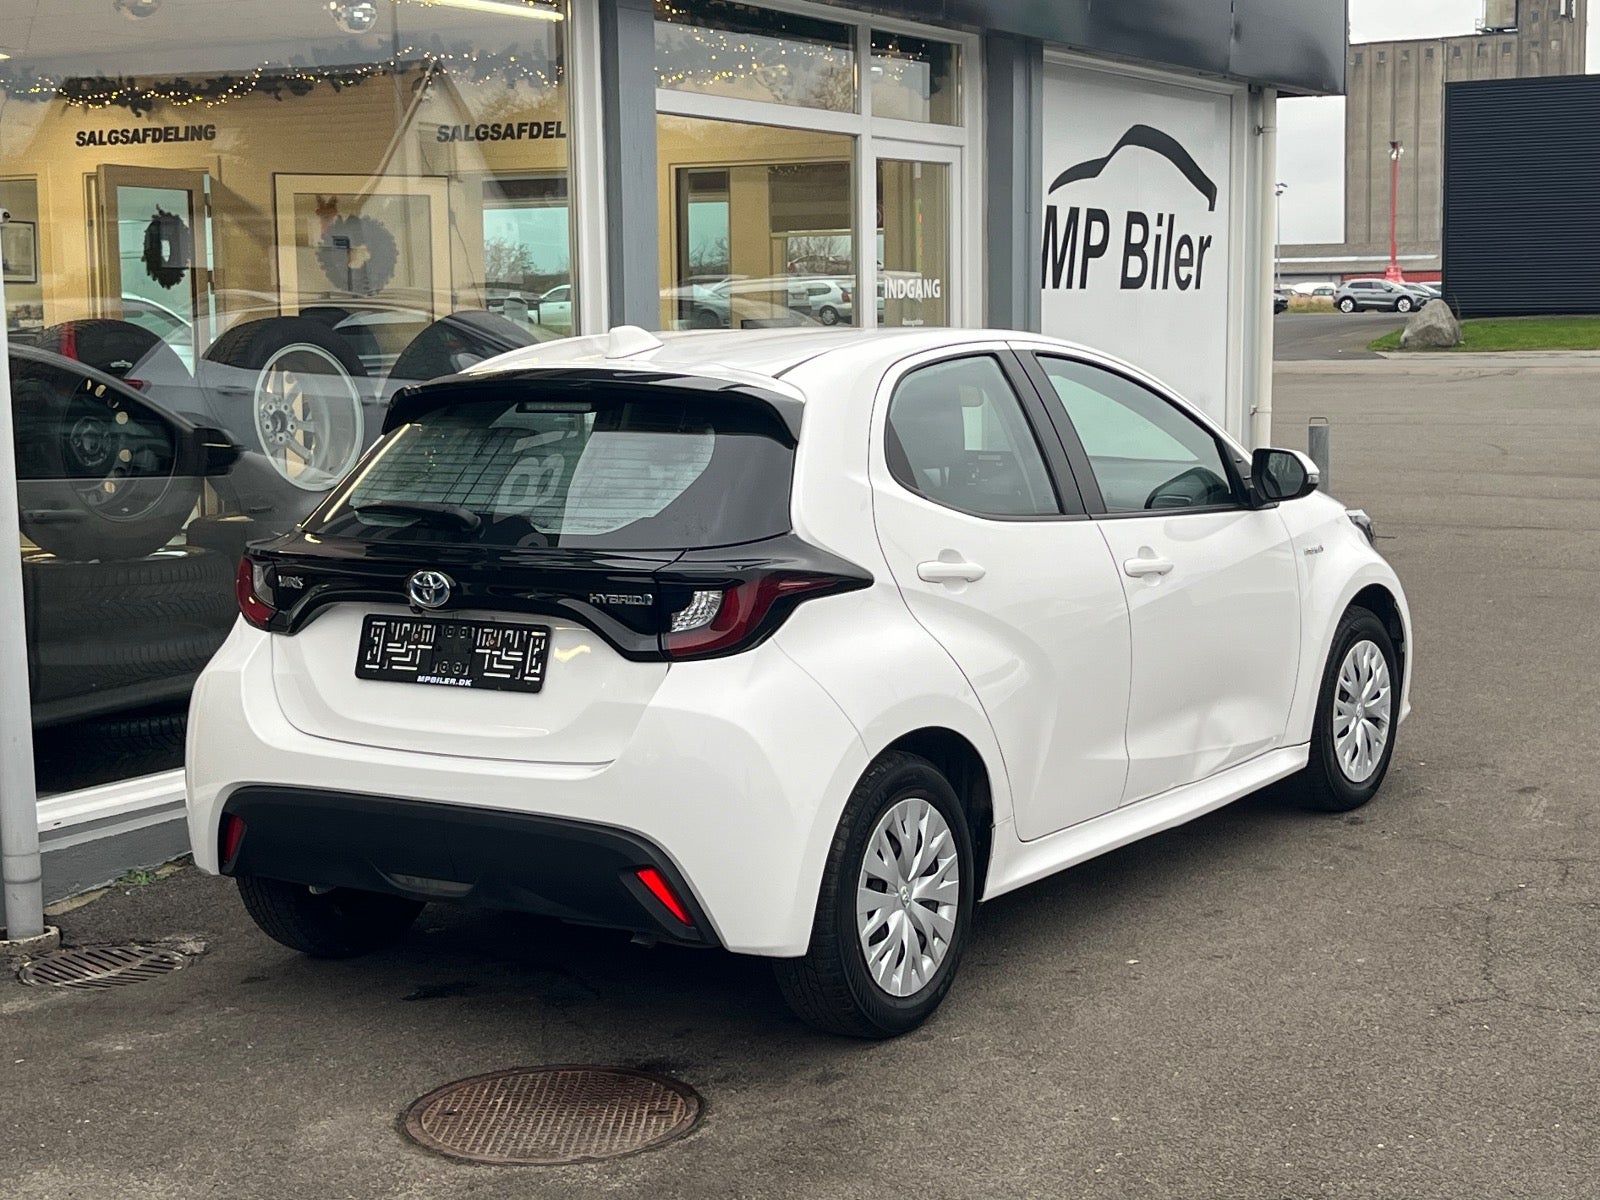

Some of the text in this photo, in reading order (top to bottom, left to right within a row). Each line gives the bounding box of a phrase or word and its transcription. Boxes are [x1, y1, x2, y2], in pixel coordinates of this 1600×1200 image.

[75, 124, 216, 147] SALGSAFDELING
[436, 121, 567, 143] SALGSAFDEL
[1042, 205, 1213, 291] MP Biler
[884, 279, 941, 300] INDGANG
[589, 593, 644, 605] HYBRID
[416, 675, 472, 687] MPBILER.DK
